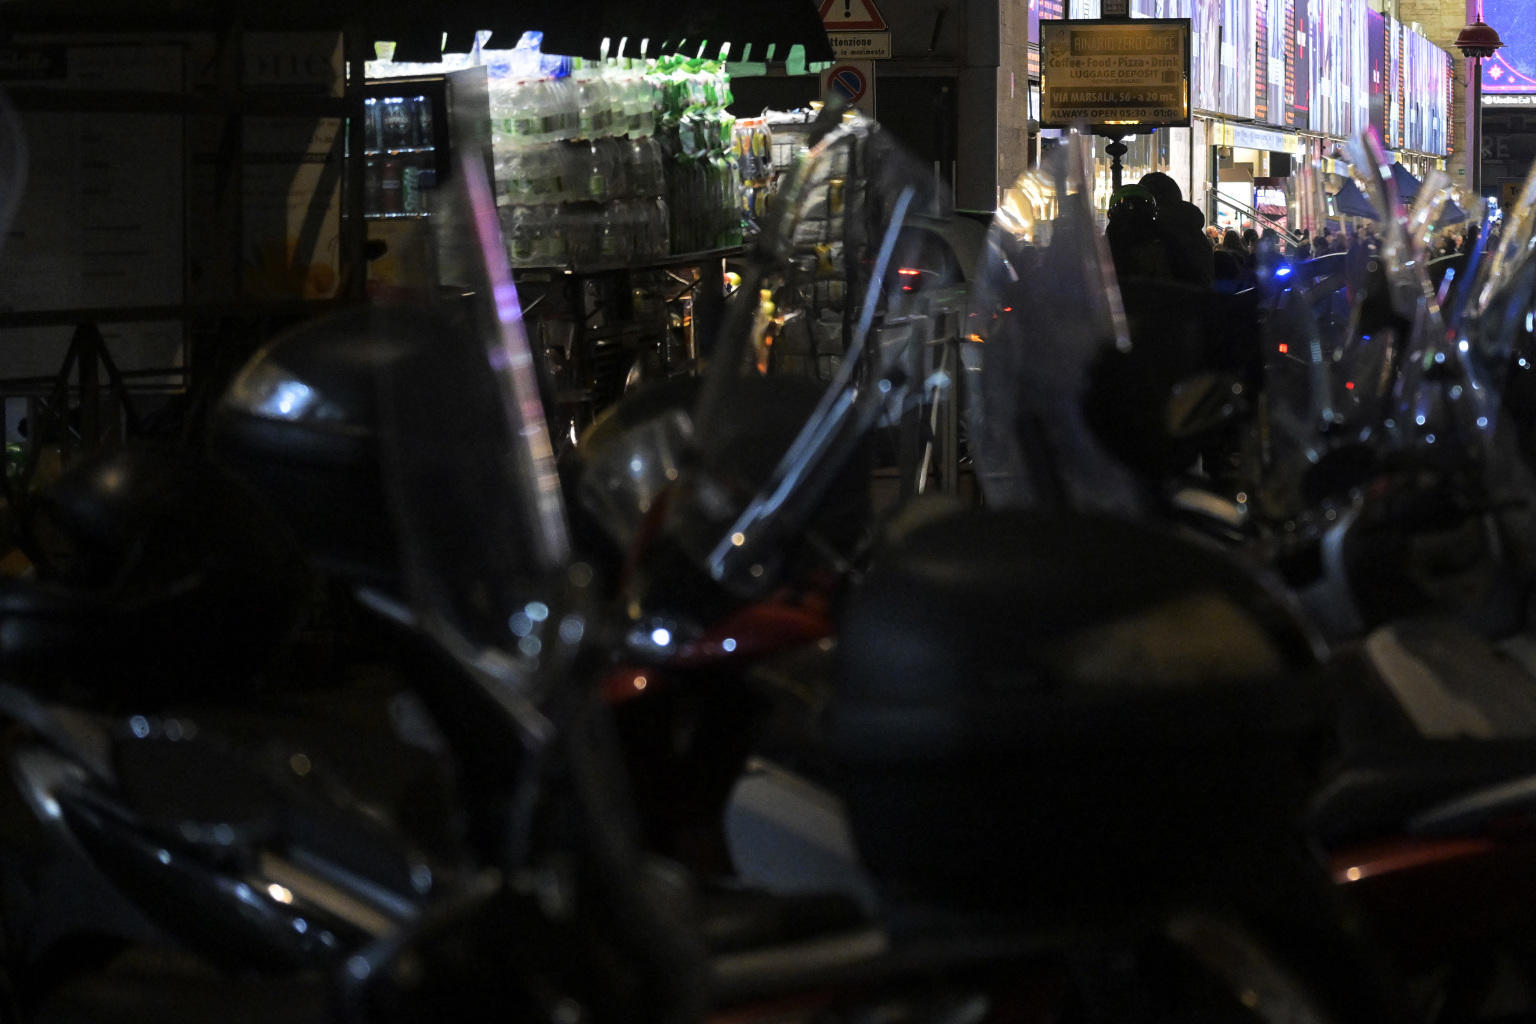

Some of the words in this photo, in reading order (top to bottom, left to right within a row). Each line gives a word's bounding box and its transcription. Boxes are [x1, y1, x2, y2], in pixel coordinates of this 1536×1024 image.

[831, 37, 872, 47] ttenzione
[1087, 57, 1111, 68] Food
[1118, 57, 1144, 68] Pizza
[1151, 56, 1179, 68] Drink
[1069, 70, 1116, 79] LUGGAGE
[1118, 70, 1158, 79] DEPOSIT
[1050, 109, 1089, 119] ALWAYS
[1090, 109, 1118, 119] OPEN
